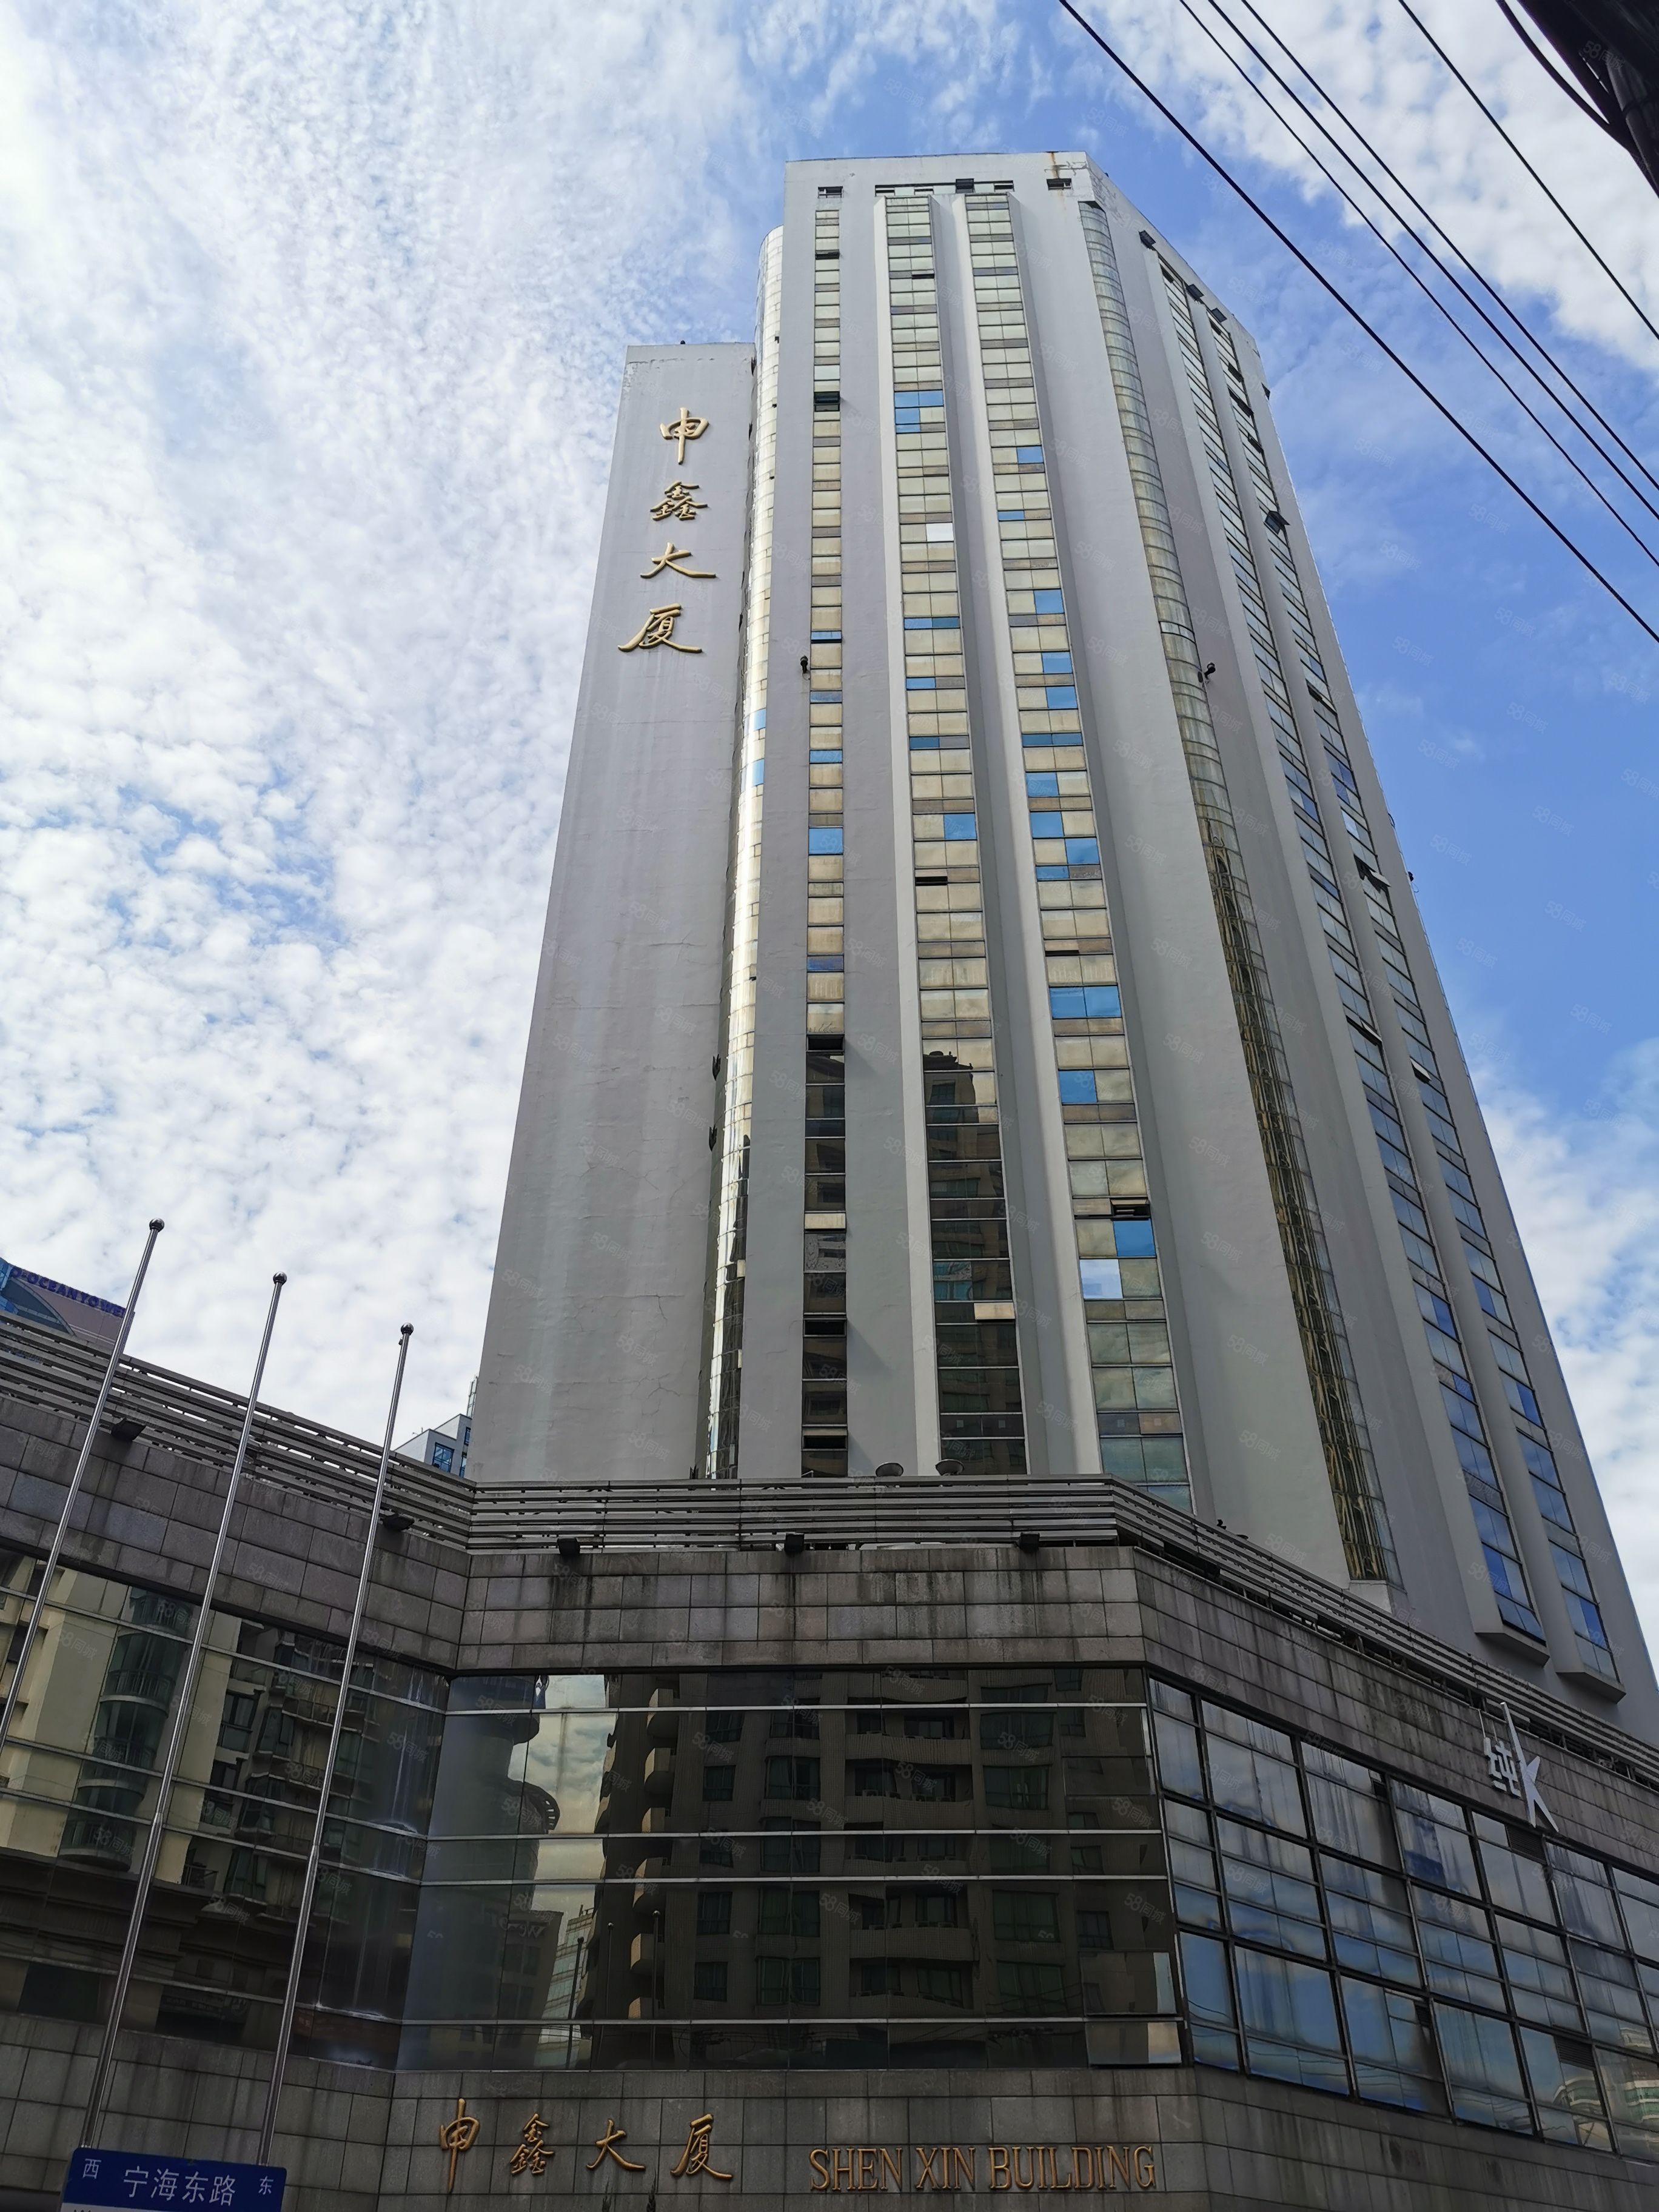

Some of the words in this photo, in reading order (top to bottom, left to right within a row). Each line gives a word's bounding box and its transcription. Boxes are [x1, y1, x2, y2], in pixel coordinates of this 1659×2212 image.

[617, 407, 717, 654] 申鑫大厦
[439, 2097, 734, 2194] 申鑫大厦
[82, 2158, 102, 2179] 西
[123, 2165, 236, 2207] 宁海东路
[258, 2175, 274, 2195] 东
[809, 2147, 903, 2192] SHEN
[915, 2147, 976, 2190] XIN
[988, 2145, 1155, 2190] BUILDING
